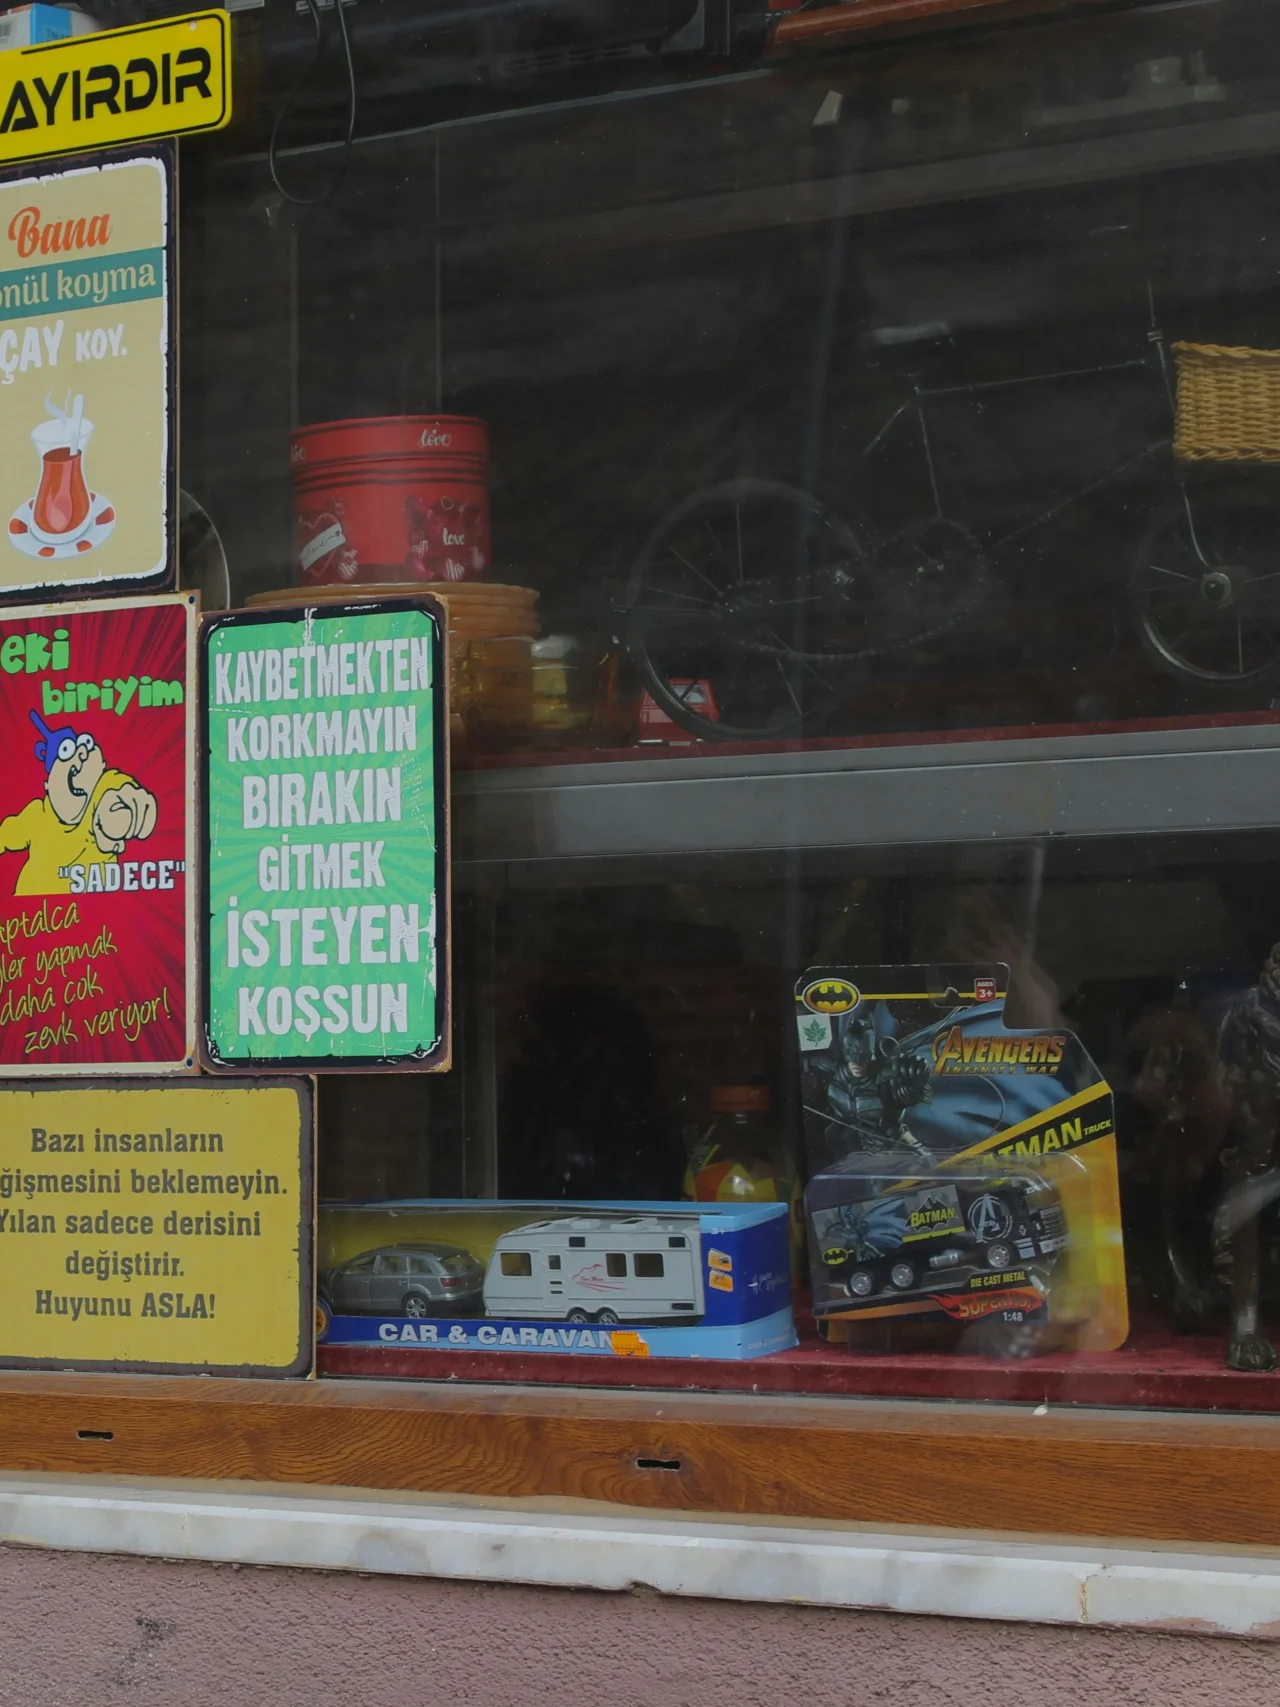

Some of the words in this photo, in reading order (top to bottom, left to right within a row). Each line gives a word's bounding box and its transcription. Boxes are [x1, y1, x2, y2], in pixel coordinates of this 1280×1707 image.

[7, 205, 111, 258] Bana
[57, 263, 157, 303] koyma
[75, 323, 128, 362] KOY.
[442, 527, 466, 546] love
[215, 637, 430, 705] KAYBETMEKTEN
[41, 675, 184, 716] biriyim
[227, 705, 417, 762] KORKMAYIN
[242, 767, 402, 829] BIRAKIN
[58, 860, 187, 894] "SADECE"
[258, 834, 386, 892] GİTMEK
[227, 896, 420, 969] İSTEYEN
[34, 925, 118, 985] yapmak
[0, 983, 56, 1026] daha
[237, 983, 408, 1042] KOŞSUN
[979, 989, 993, 998] 3+
[24, 1011, 79, 1054] zevk
[83, 986, 171, 1042] veriyor!
[931, 1025, 1067, 1074] AVENGERS
[31, 1127, 85, 1153] Bazı
[94, 1127, 224, 1153] insanların
[1083, 1119, 1112, 1136] TRUCK
[131, 1168, 288, 1200] beklemeyin.
[65, 1209, 154, 1235] sadece
[163, 1210, 261, 1236] derisini
[910, 1207, 956, 1227] BATMAN
[65, 1249, 185, 1283] değiştirir.
[970, 1277, 983, 1288] DIE
[983, 1274, 1001, 1286] CAST
[1003, 1271, 1026, 1283] METAL
[35, 1290, 131, 1322] Huyunu
[141, 1292, 216, 1319] ASLA!
[1002, 1311, 1024, 1322] 1:48
[378, 1323, 439, 1344] CAR
[448, 1325, 469, 1345] &
